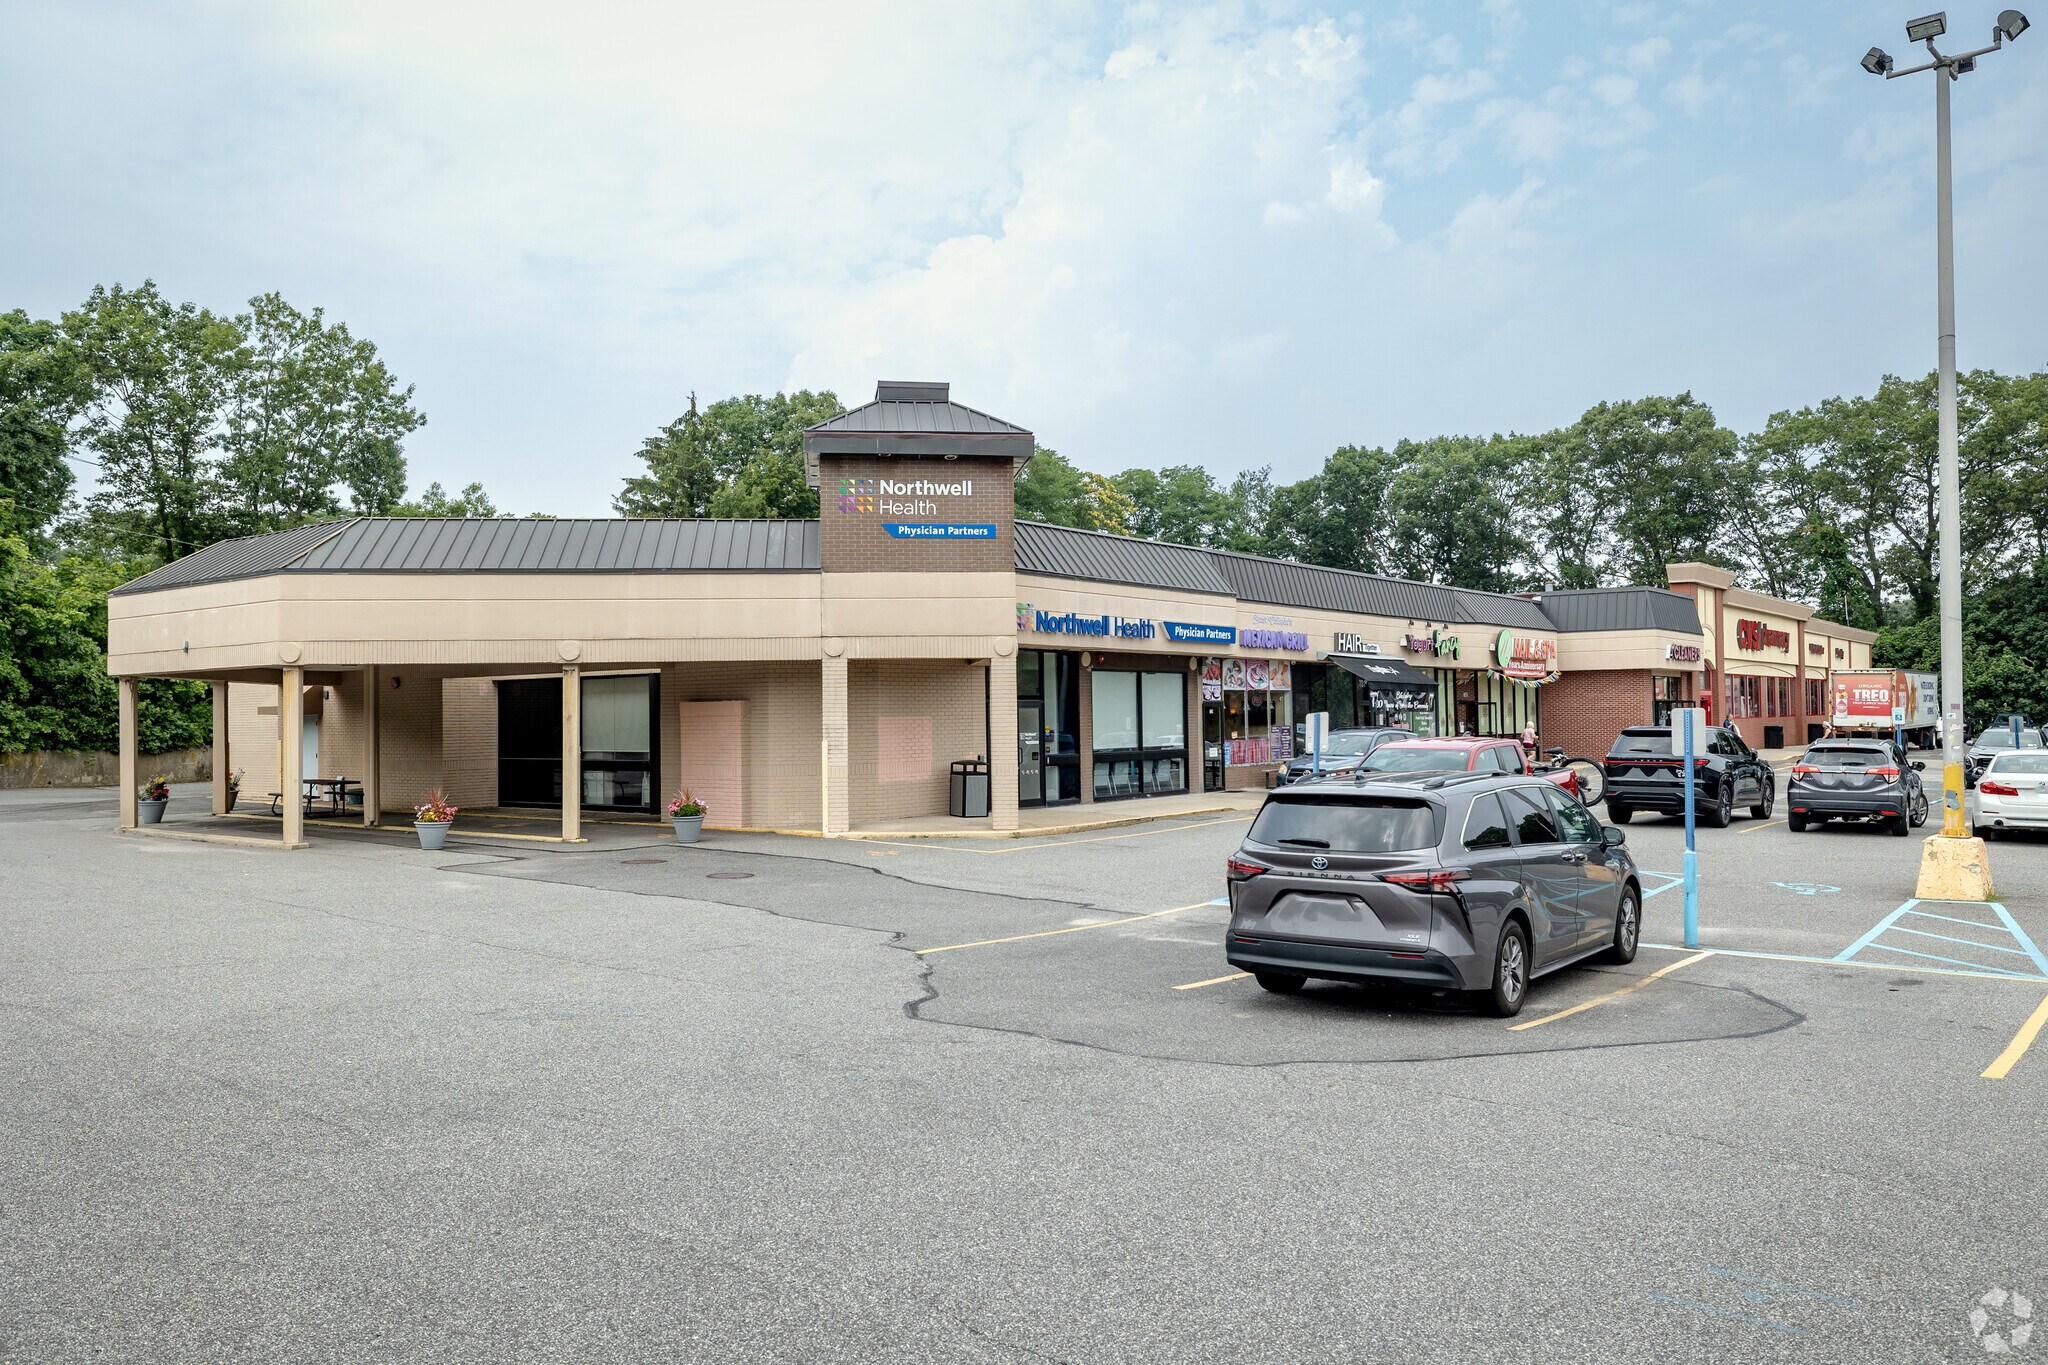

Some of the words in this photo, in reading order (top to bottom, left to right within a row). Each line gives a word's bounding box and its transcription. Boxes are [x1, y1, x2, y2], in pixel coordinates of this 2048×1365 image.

[880, 479, 973, 496] Northwell
[880, 499, 937, 516] Health
[898, 525, 945, 537] Physician
[948, 526, 988, 536] Partners
[1036, 610, 1110, 637] Northwell
[1115, 616, 1156, 639] Health
[1175, 625, 1205, 640] Physician
[1206, 628, 1231, 640] Partners
[1241, 629, 1283, 649] MEXICAN
[1285, 631, 1309, 651] GRILL
[1337, 632, 1362, 652] HAIR
[1738, 618, 1760, 652] CVS
[1513, 638, 1533, 659] NAIL
[1534, 639, 1541, 659] &
[1541, 639, 1556, 660] SPA
[1853, 689, 1889, 702] TREO
[1286, 871, 1356, 880] SIENNA
